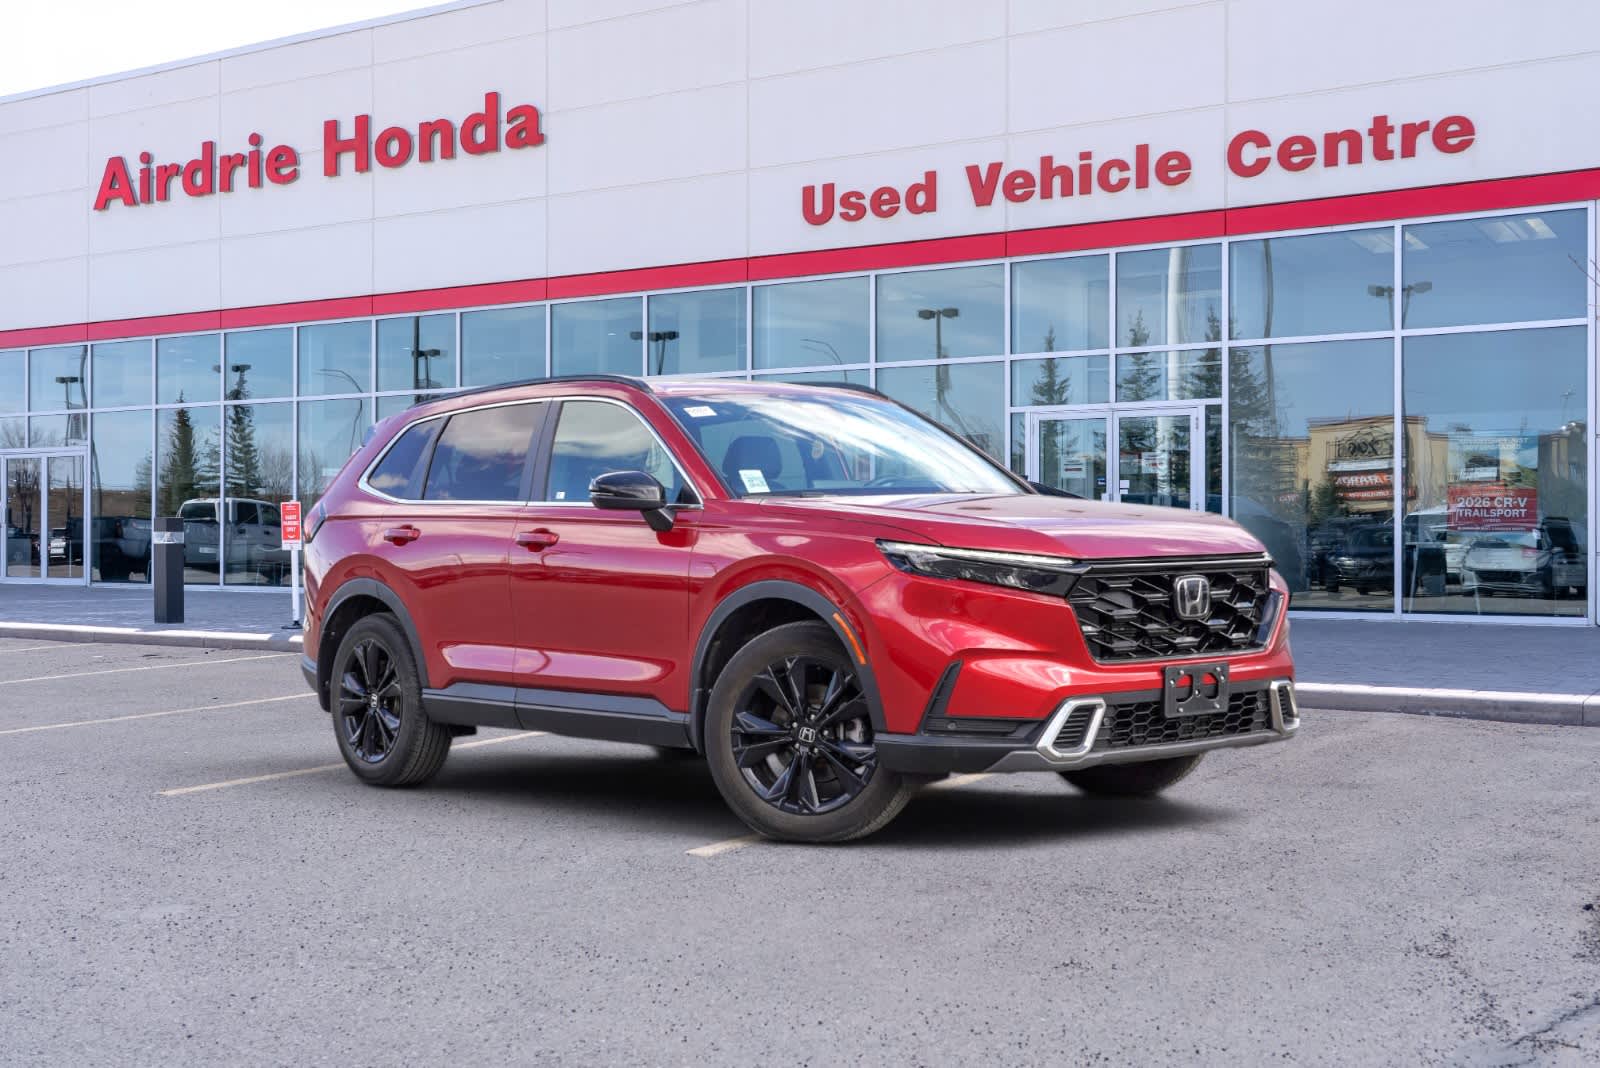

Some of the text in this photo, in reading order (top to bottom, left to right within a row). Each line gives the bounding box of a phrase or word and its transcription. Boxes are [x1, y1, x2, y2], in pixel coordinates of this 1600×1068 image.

[94, 92, 547, 211] Airdrie Honda
[801, 114, 1476, 226] Used Vehicle Centre
[1457, 496, 1528, 508] 2026 CR-V
[1458, 508, 1528, 518] TRAILSPORT
